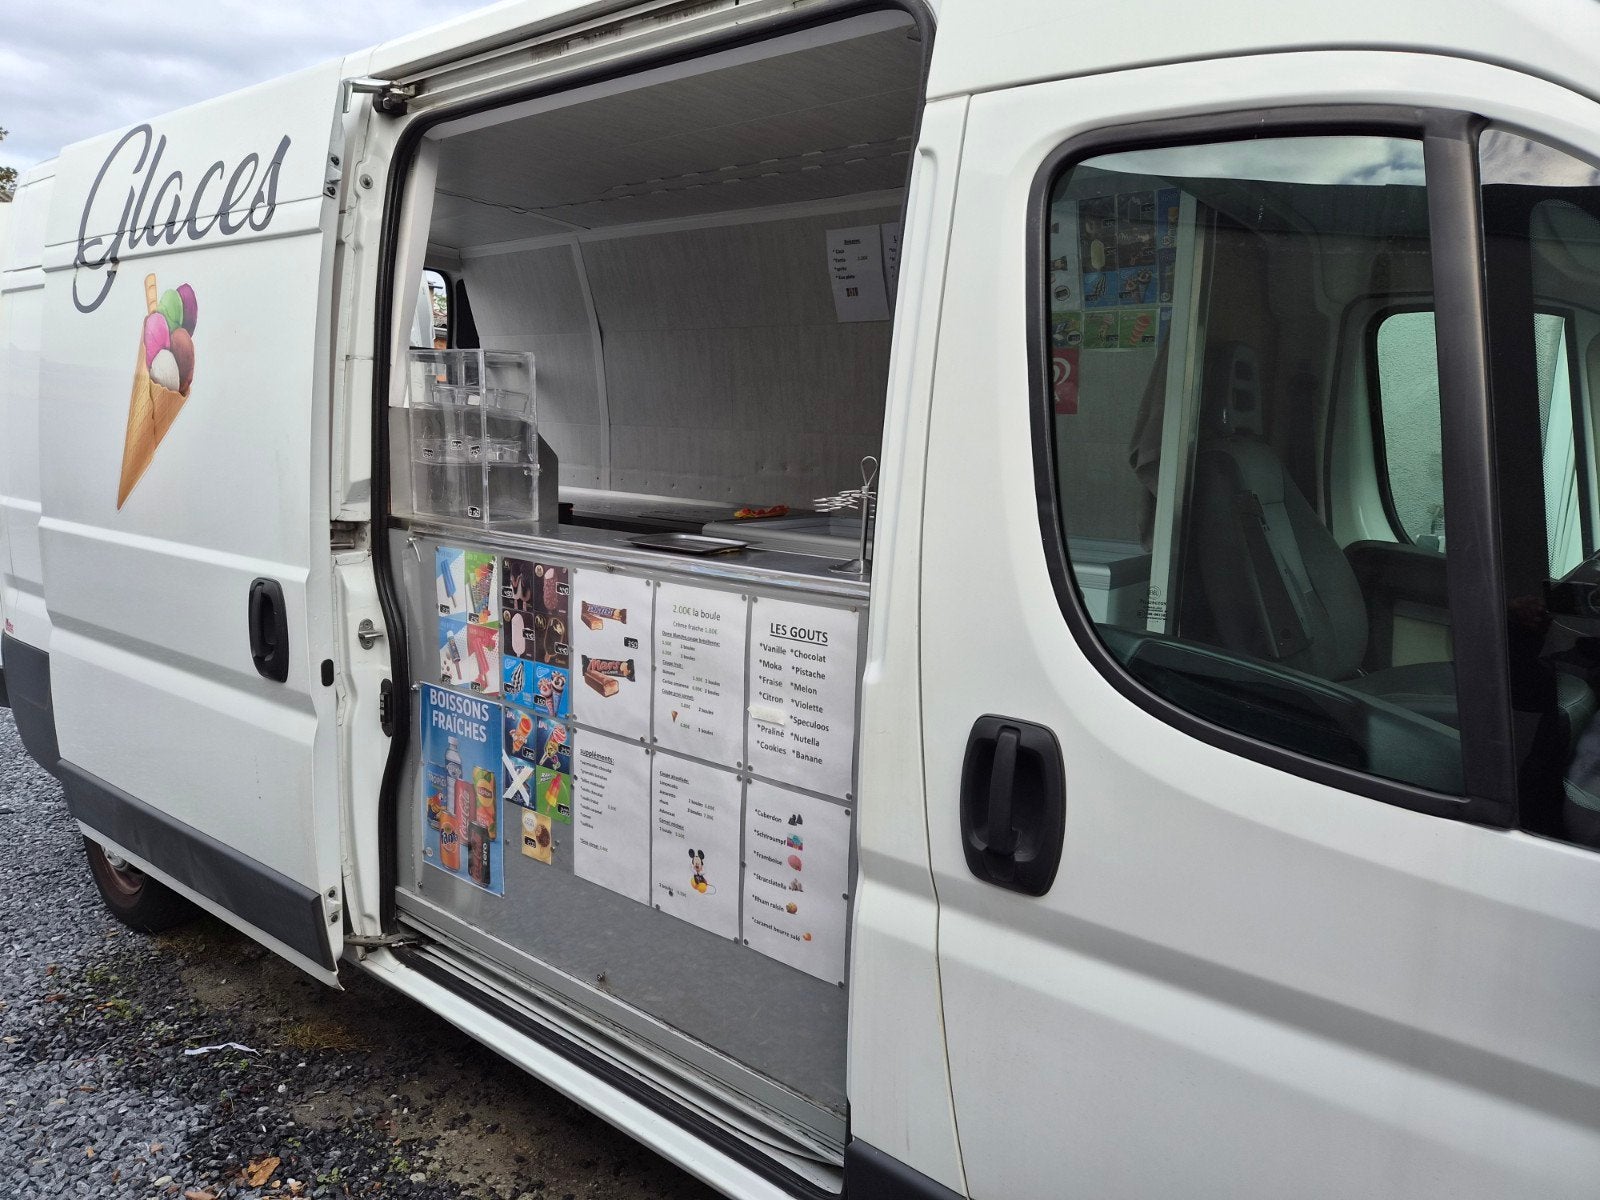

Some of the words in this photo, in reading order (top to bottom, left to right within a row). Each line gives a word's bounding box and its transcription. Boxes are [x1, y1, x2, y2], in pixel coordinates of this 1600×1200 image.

[72, 123, 291, 313] Glaces
[692, 608, 699, 617] la
[700, 610, 721, 621] boule
[770, 622, 787, 636] LES
[789, 626, 828, 644] GOUTS
[762, 643, 787, 656] Vanille
[793, 649, 826, 663] Chocolat
[762, 660, 783, 671] Moka
[795, 666, 826, 680] Pistache
[762, 676, 783, 688] Fraise
[793, 683, 818, 695] Melon
[429, 688, 490, 722] BOISSONS
[762, 692, 784, 704] Citron
[794, 699, 824, 713] Violette
[793, 716, 829, 732] Speculoos
[761, 725, 785, 738] Praliné
[793, 733, 820, 747] Nutella
[760, 741, 787, 755] Cookies
[795, 750, 823, 765] Banane
[755, 851, 783, 866] Framboise
[753, 918, 773, 931] caramel
[773, 925, 790, 938] beurre
